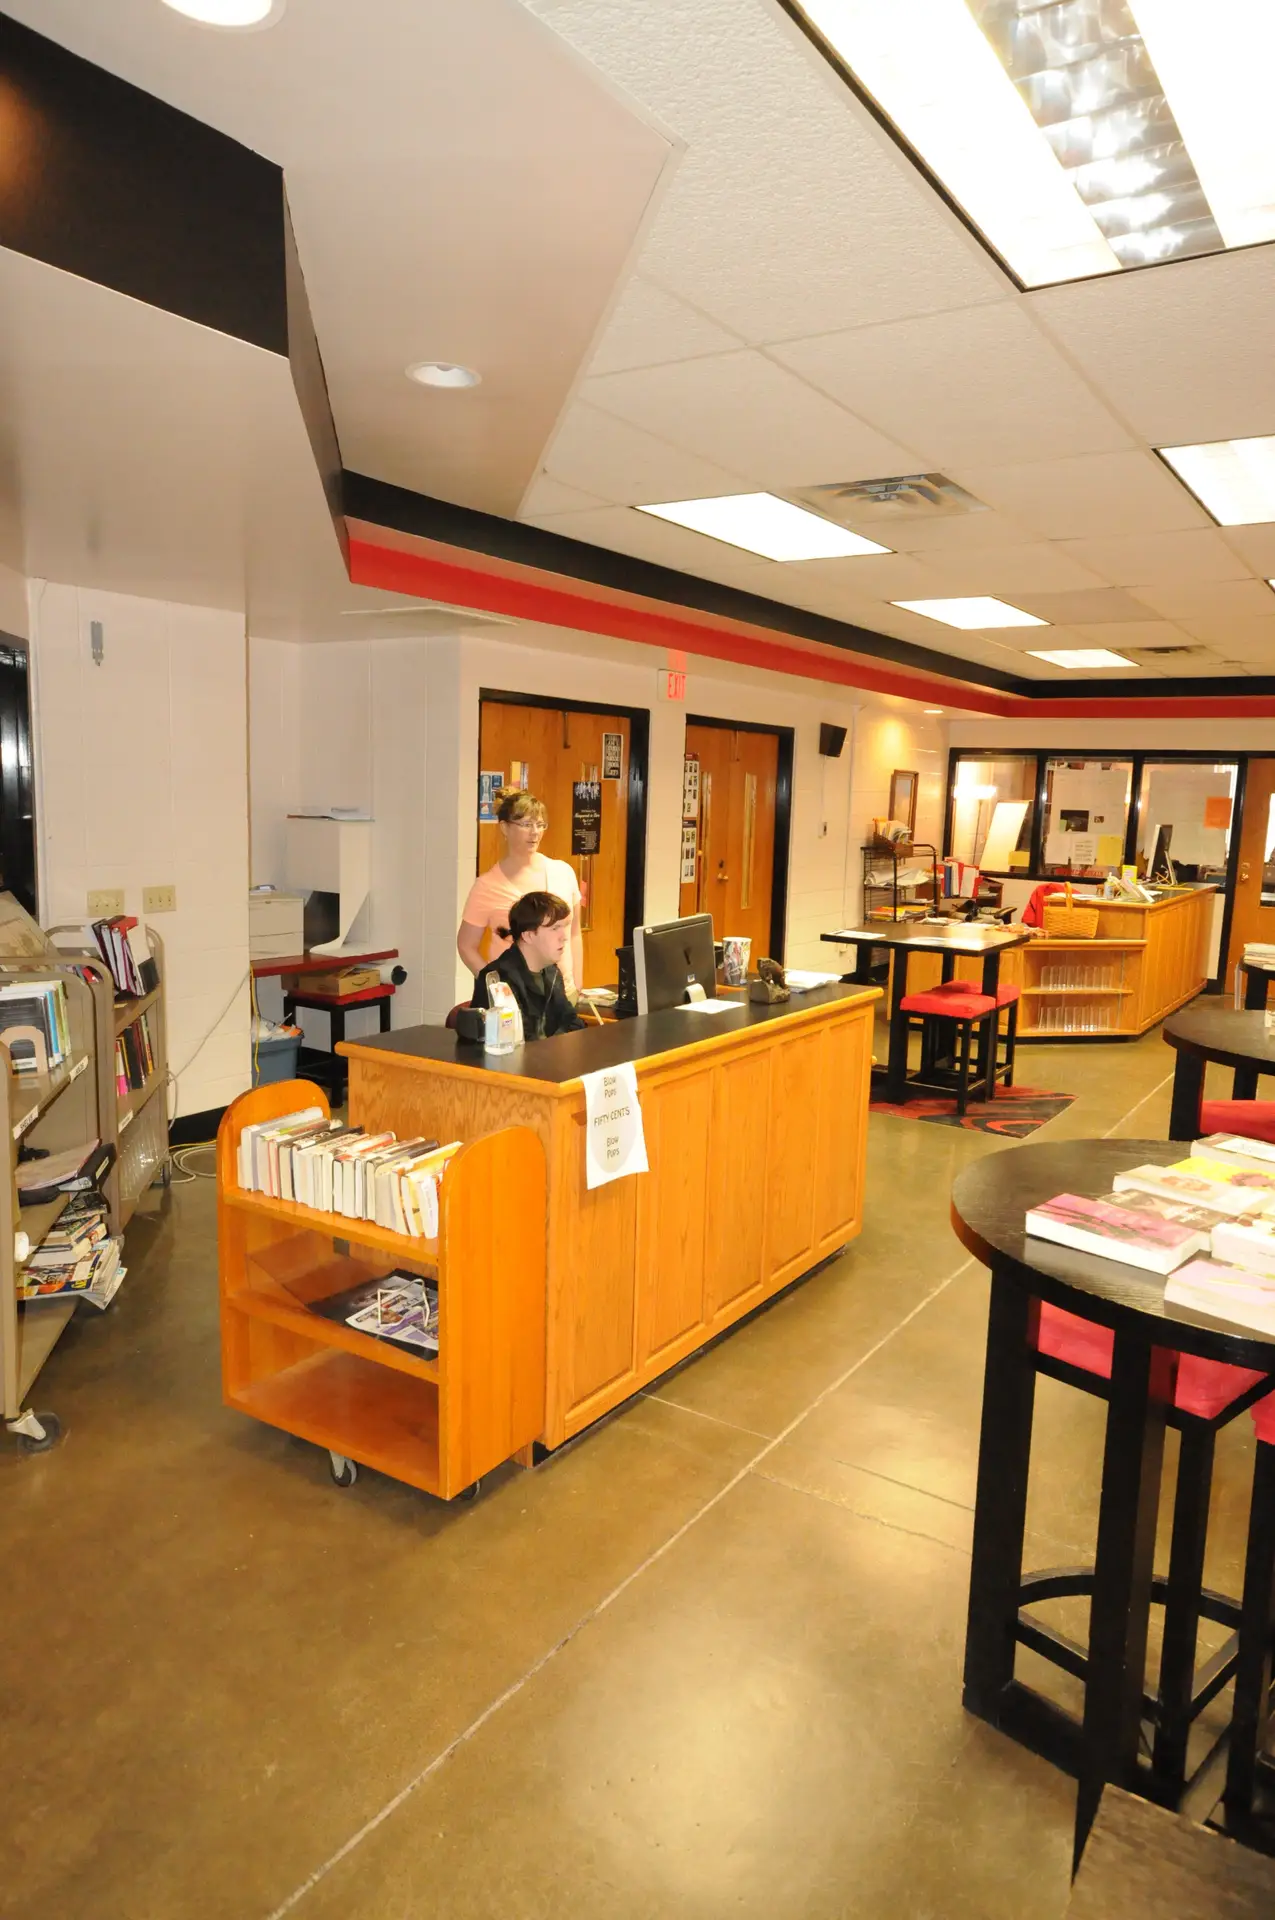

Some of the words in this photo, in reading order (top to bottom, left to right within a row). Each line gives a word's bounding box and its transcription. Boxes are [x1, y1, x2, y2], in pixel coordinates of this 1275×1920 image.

[667, 672, 686, 700] EXIT
[594, 1112, 610, 1127] FIFTY
[610, 1106, 630, 1121] CENTS
